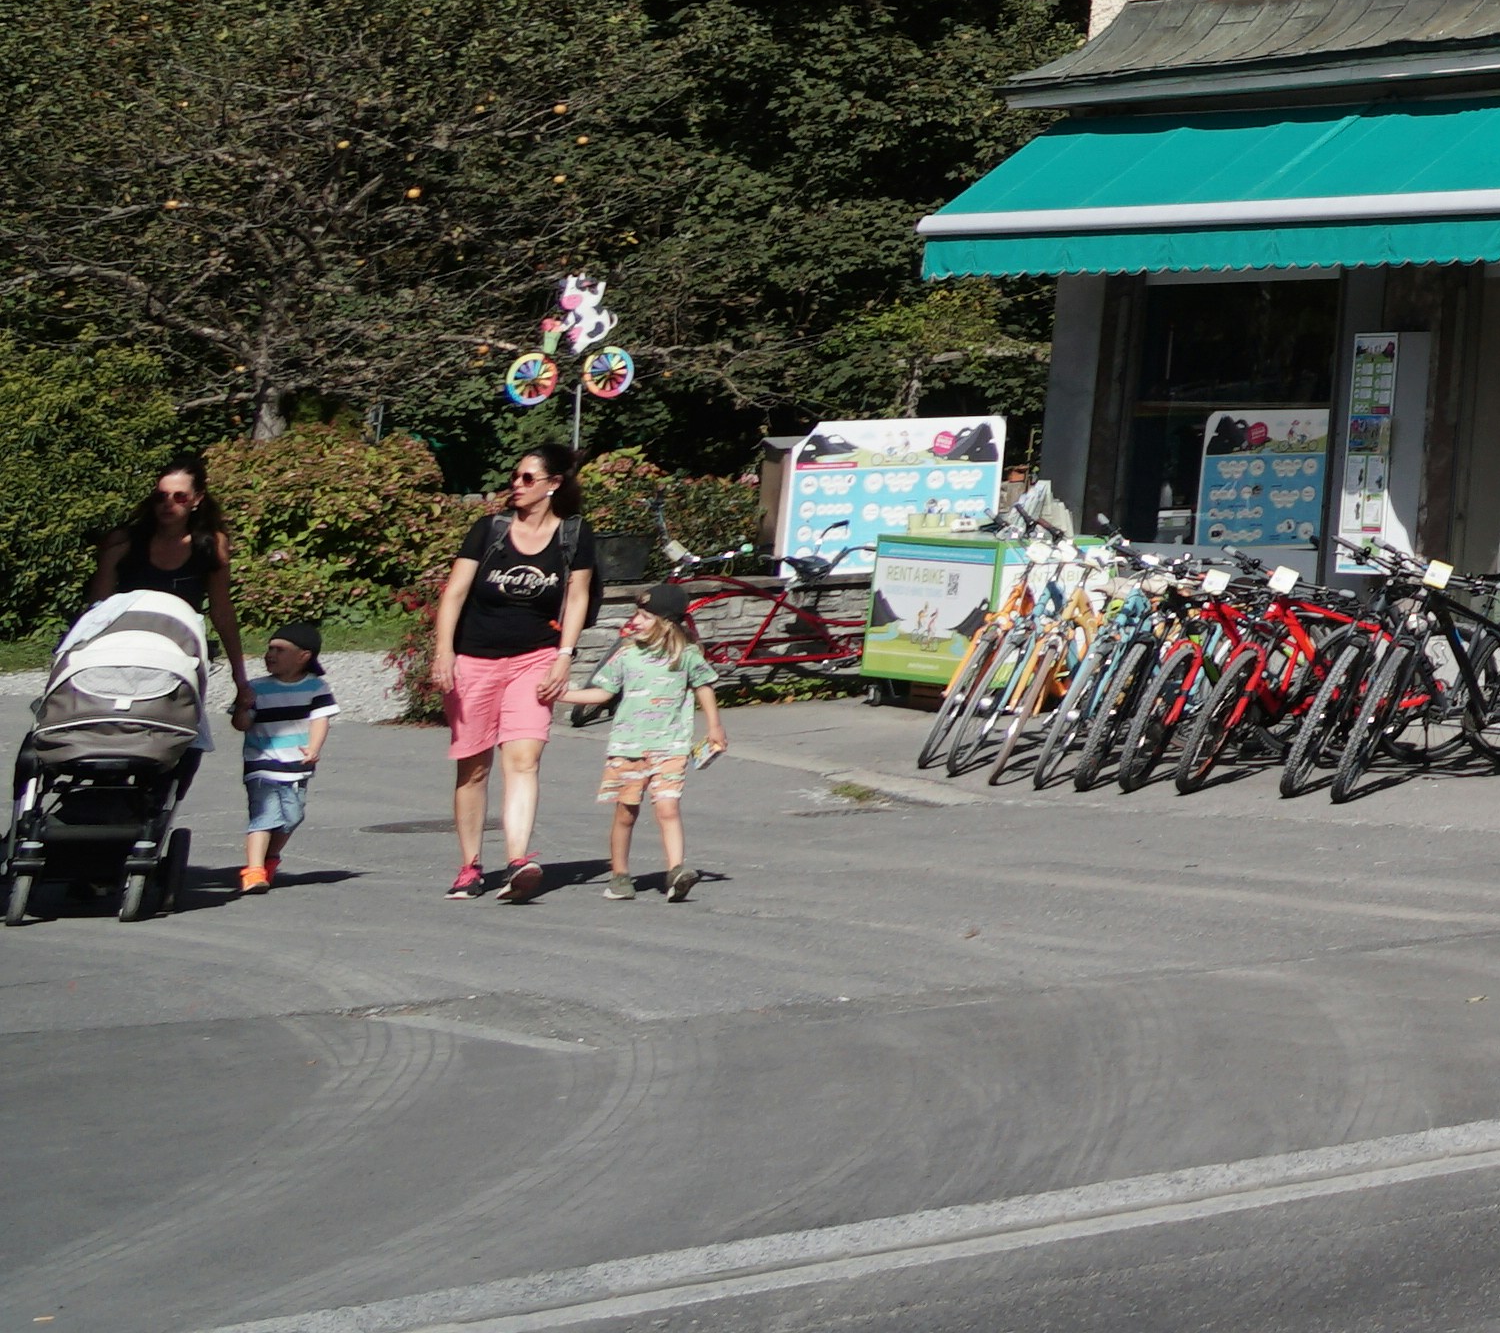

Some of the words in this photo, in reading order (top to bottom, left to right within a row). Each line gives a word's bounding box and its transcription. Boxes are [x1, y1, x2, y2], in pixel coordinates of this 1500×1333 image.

[486, 569, 523, 585] Hard
[523, 573, 559, 589] Rock
[886, 565, 911, 581] RENT
[921, 568, 945, 585] BIKE
